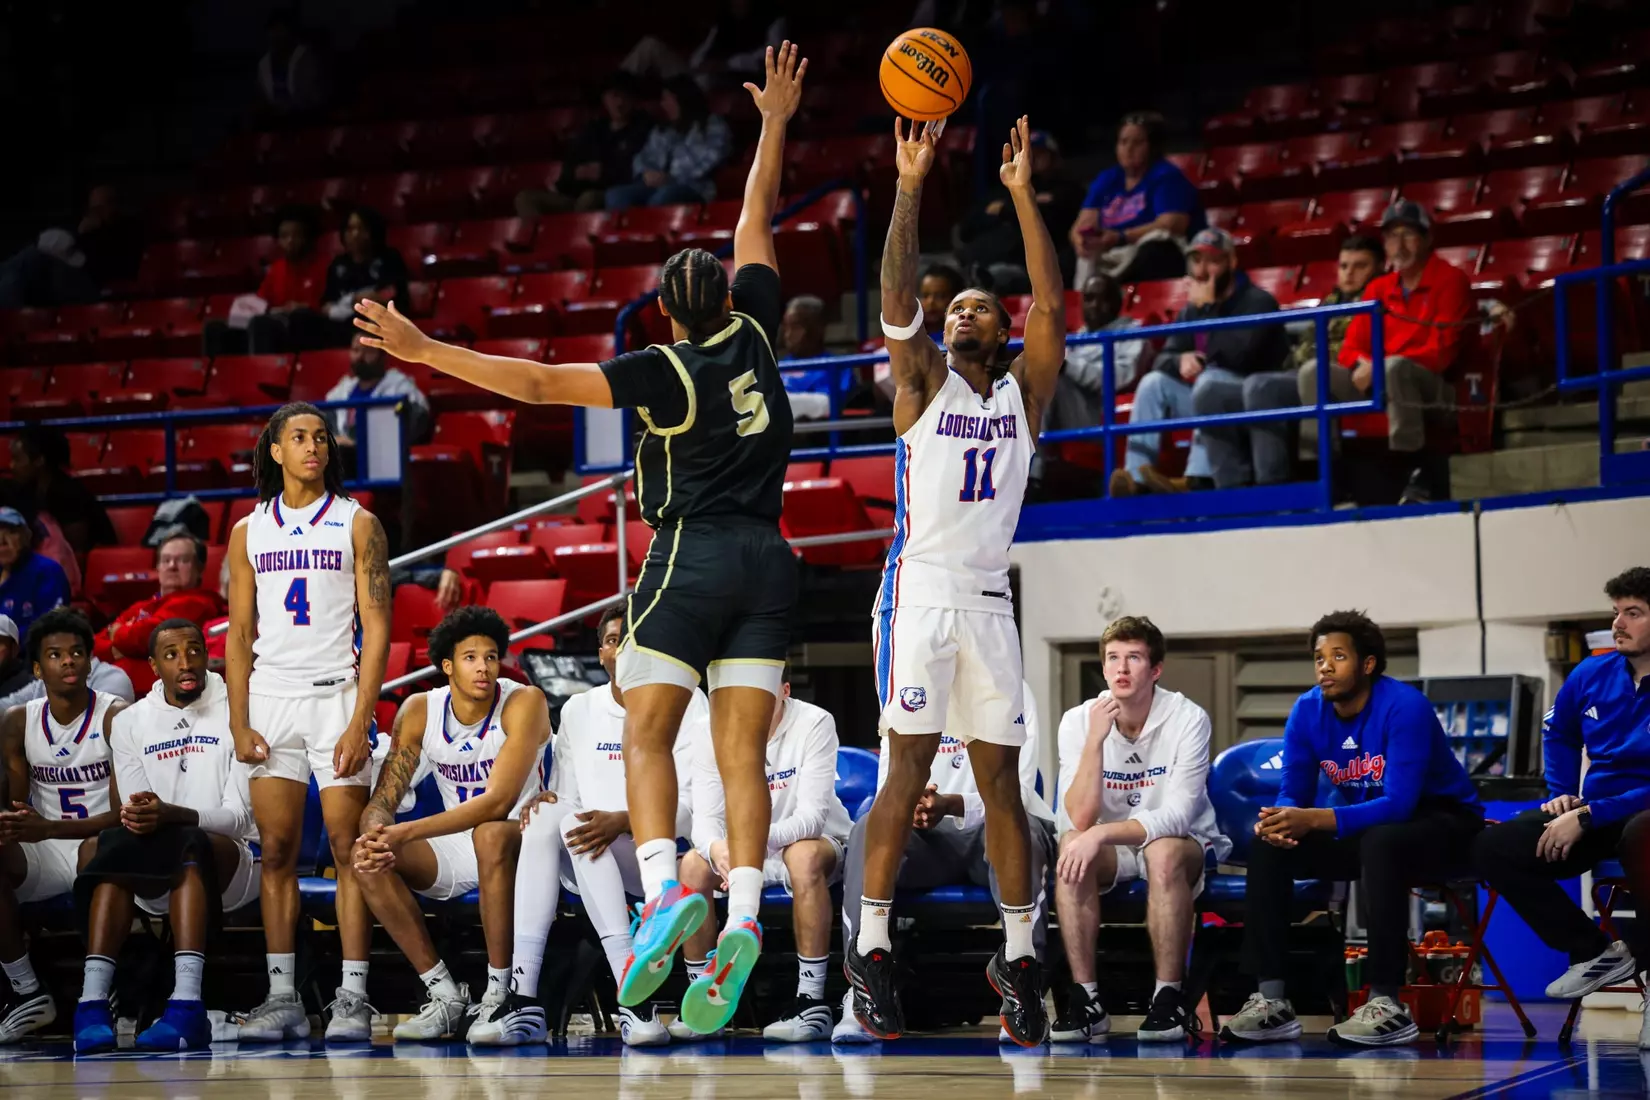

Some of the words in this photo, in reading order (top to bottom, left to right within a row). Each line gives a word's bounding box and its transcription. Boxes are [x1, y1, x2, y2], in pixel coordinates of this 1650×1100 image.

[899, 43, 950, 88] Wilson
[728, 368, 770, 437] 5
[936, 411, 993, 441] LOUISIA
[959, 447, 996, 502] 11
[255, 549, 310, 574] LOUISIANA
[312, 549, 342, 571] TECH
[284, 577, 310, 625] 4
[157, 746, 205, 760] BASKETALL
[195, 735, 220, 745] TECH
[80, 760, 111, 782] TECH
[1103, 770, 1146, 782] OUISIANA
[1147, 766, 1167, 777] TCH
[1320, 751, 1386, 785] Bulldg
[58, 787, 89, 820] 5
